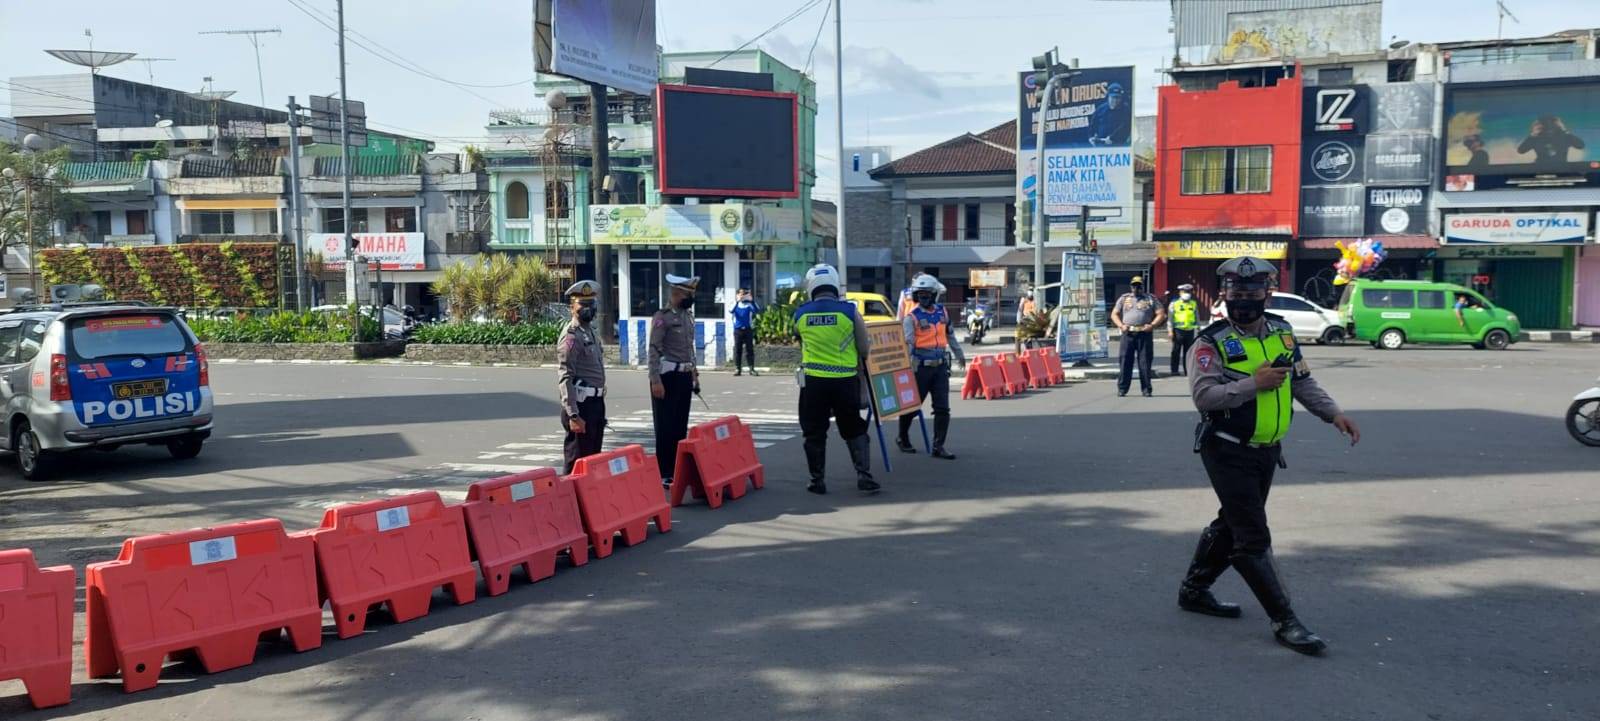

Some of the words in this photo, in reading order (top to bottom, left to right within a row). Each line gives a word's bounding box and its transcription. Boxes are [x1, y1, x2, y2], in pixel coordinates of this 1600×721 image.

[1071, 82, 1108, 103] DRUGS
[1048, 153, 1131, 169] SELAMATKAN
[1048, 170, 1078, 183] ANAK
[1080, 169, 1105, 182] KITA
[1048, 183, 1069, 194] DARI
[1072, 182, 1112, 193] BAHAYA
[1048, 192, 1117, 204] PENYALAHGUNAAN
[1451, 219, 1511, 229] GARUDA
[1516, 218, 1581, 228] OPTIKAL
[351, 235, 408, 253] AMAHA
[1200, 240, 1242, 250] PONDOK
[807, 316, 836, 326] POLISI
[83, 391, 195, 424] POLISI
